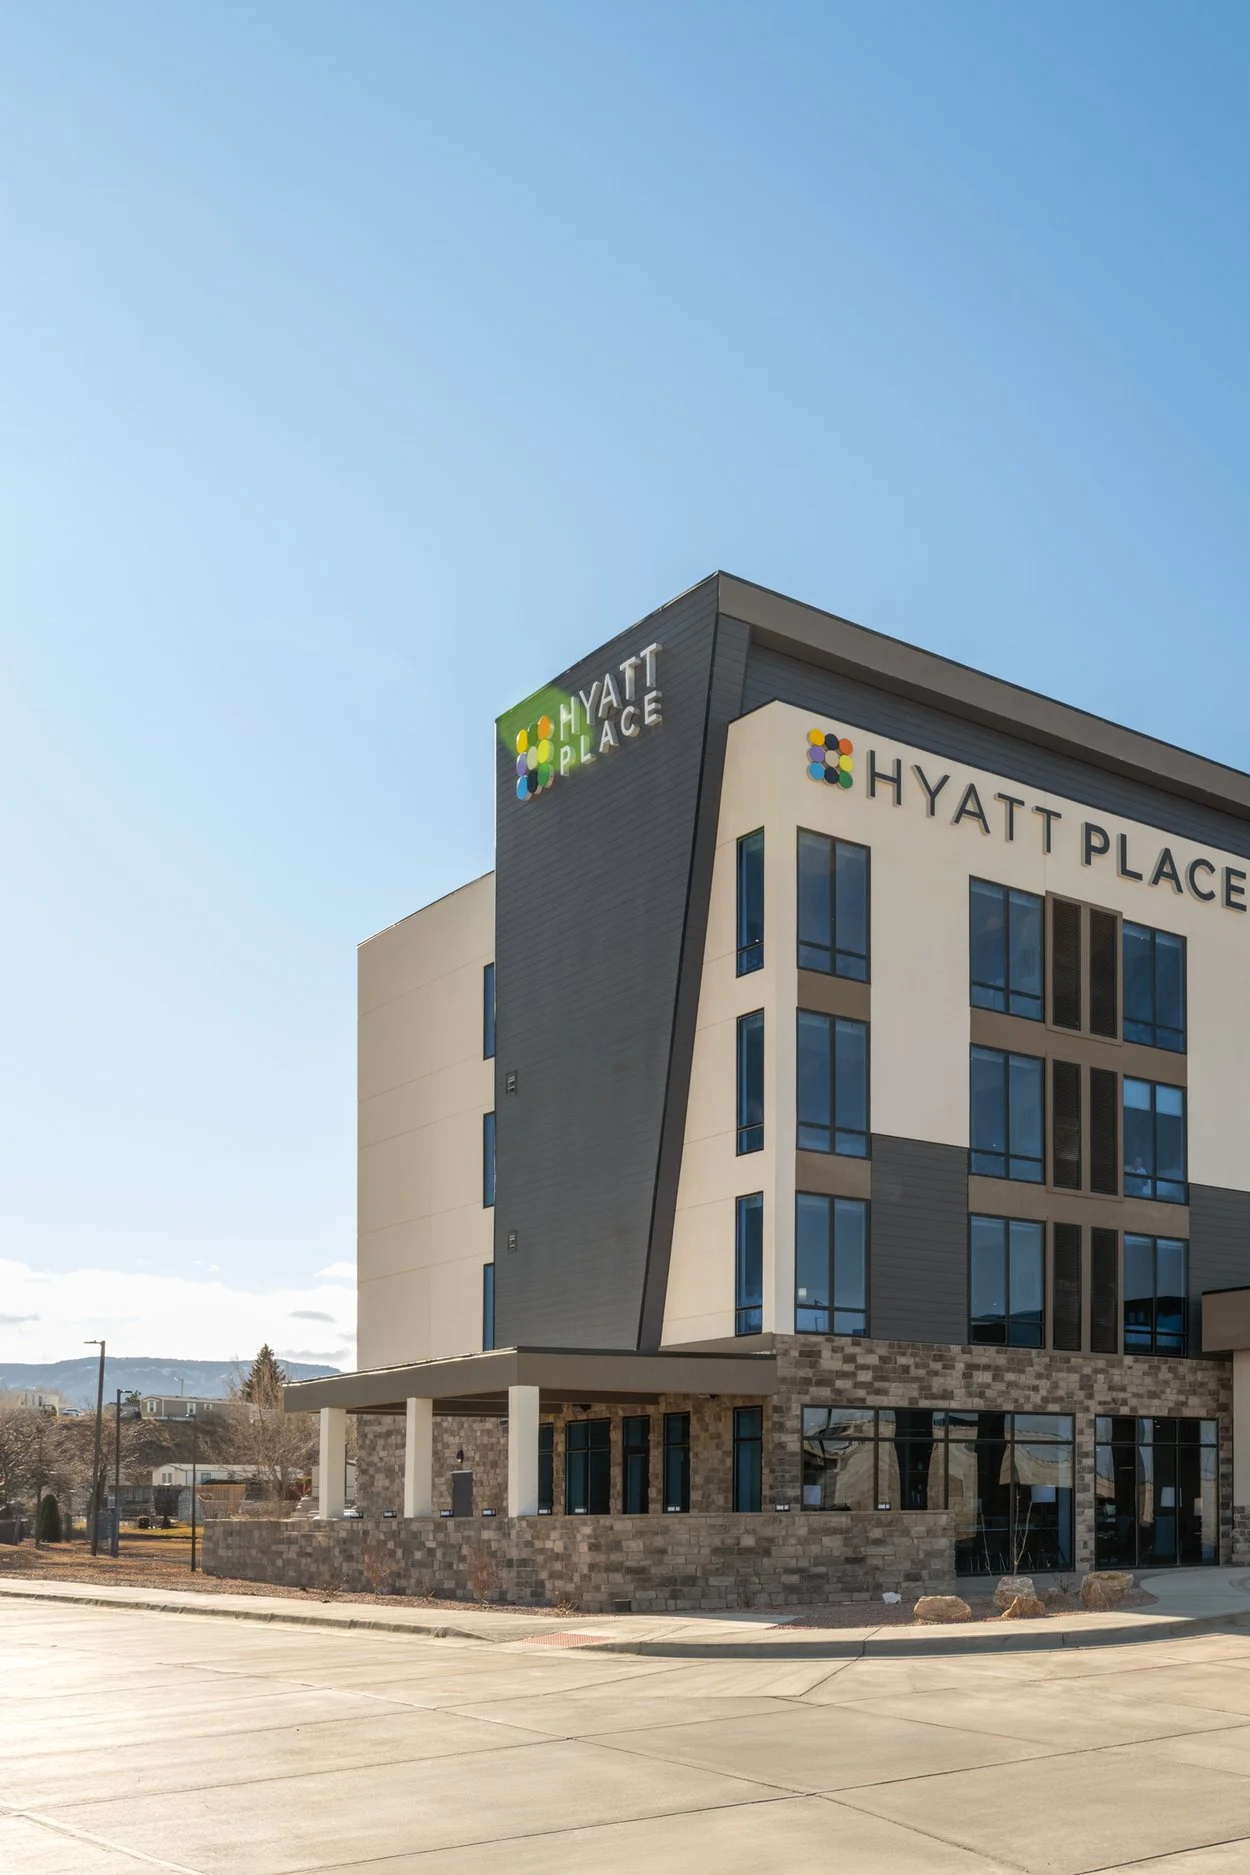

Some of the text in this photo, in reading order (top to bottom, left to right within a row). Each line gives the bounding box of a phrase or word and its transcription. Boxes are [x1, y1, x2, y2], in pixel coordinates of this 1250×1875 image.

[560, 642, 663, 741] HYATT
[560, 690, 662, 776] PLACE
[867, 750, 1247, 912] HYATT PLACE
